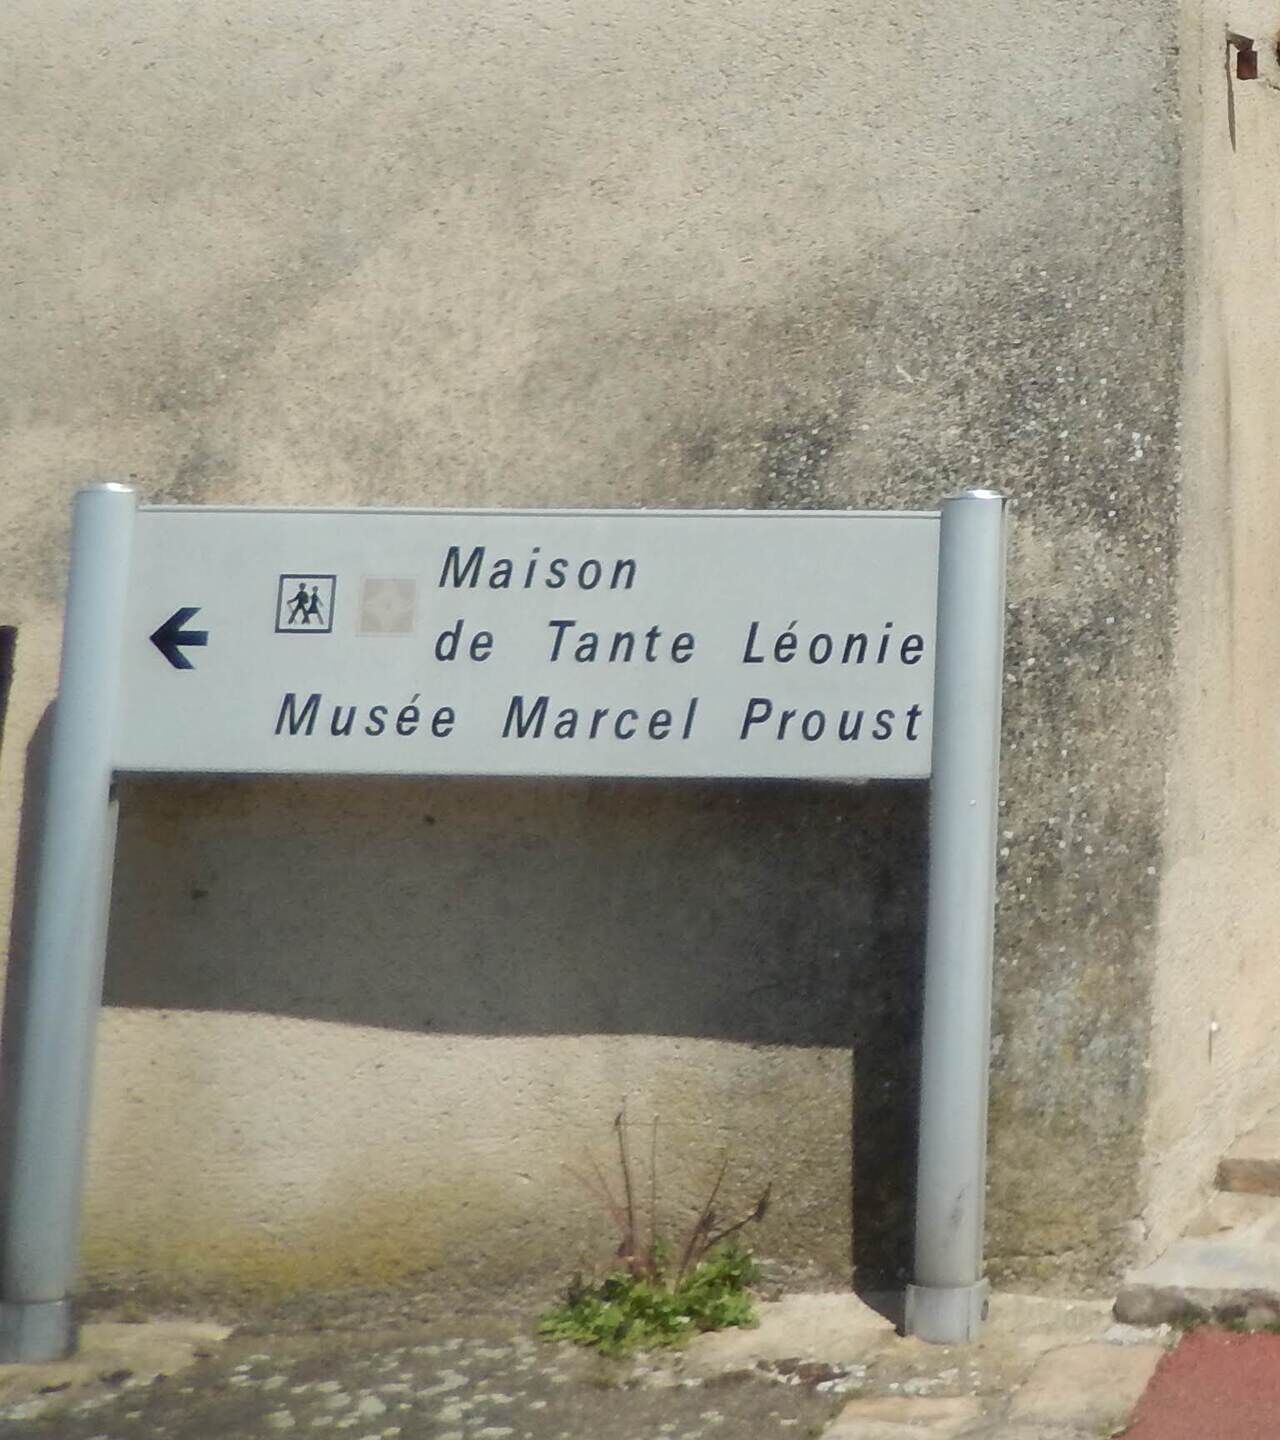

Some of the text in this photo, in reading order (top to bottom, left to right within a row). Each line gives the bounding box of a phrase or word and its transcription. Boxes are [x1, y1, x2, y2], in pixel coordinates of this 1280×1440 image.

[438, 545, 637, 590] Maison
[434, 619, 925, 665] de Tante Léonie
[273, 692, 923, 742] Musée Marcel Proust
